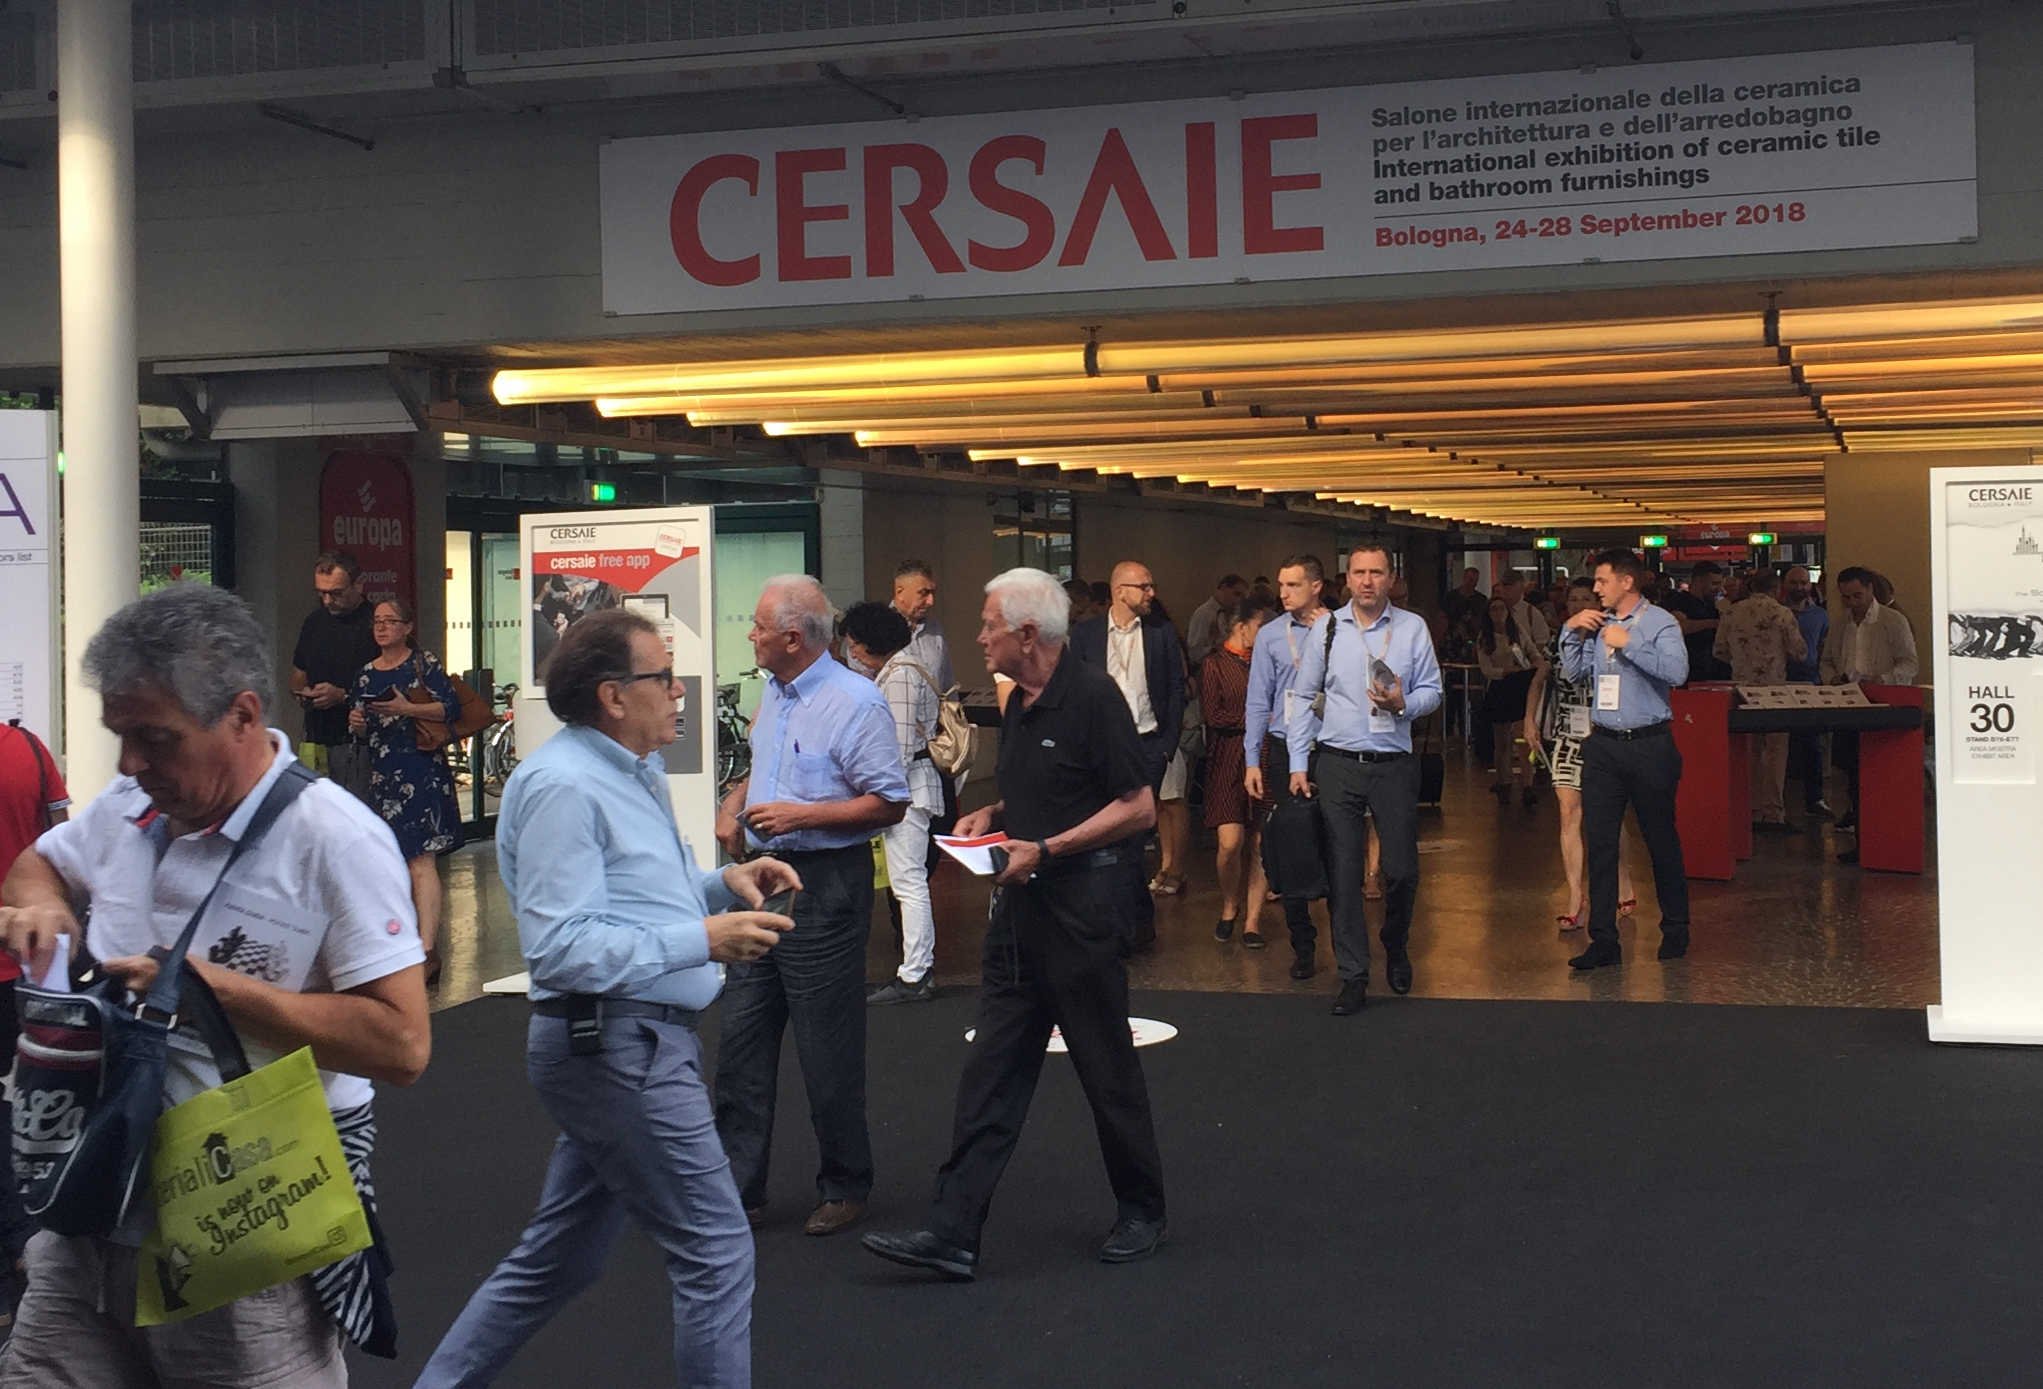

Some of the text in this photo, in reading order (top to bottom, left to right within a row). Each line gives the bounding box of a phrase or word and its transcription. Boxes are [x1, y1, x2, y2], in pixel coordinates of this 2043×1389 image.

[1371, 75, 1862, 128] Salone internazionale della ceramica
[1373, 135, 1415, 157] per
[1599, 121, 1615, 137] e
[1374, 126, 1881, 178] International exhibition of ceramic tile
[669, 113, 1325, 287] CERSAIE
[1374, 166, 1710, 204] and bathroom furnishings
[1375, 202, 1806, 248] Bologna, 24-28 September 2018
[1968, 488, 2033, 501] CERSAIE
[334, 516, 402, 551] europa
[550, 527, 597, 539] CERSAIE
[550, 553, 651, 569] cersaie free app
[1968, 686, 2015, 699] HALL
[1970, 703, 2015, 733] 30
